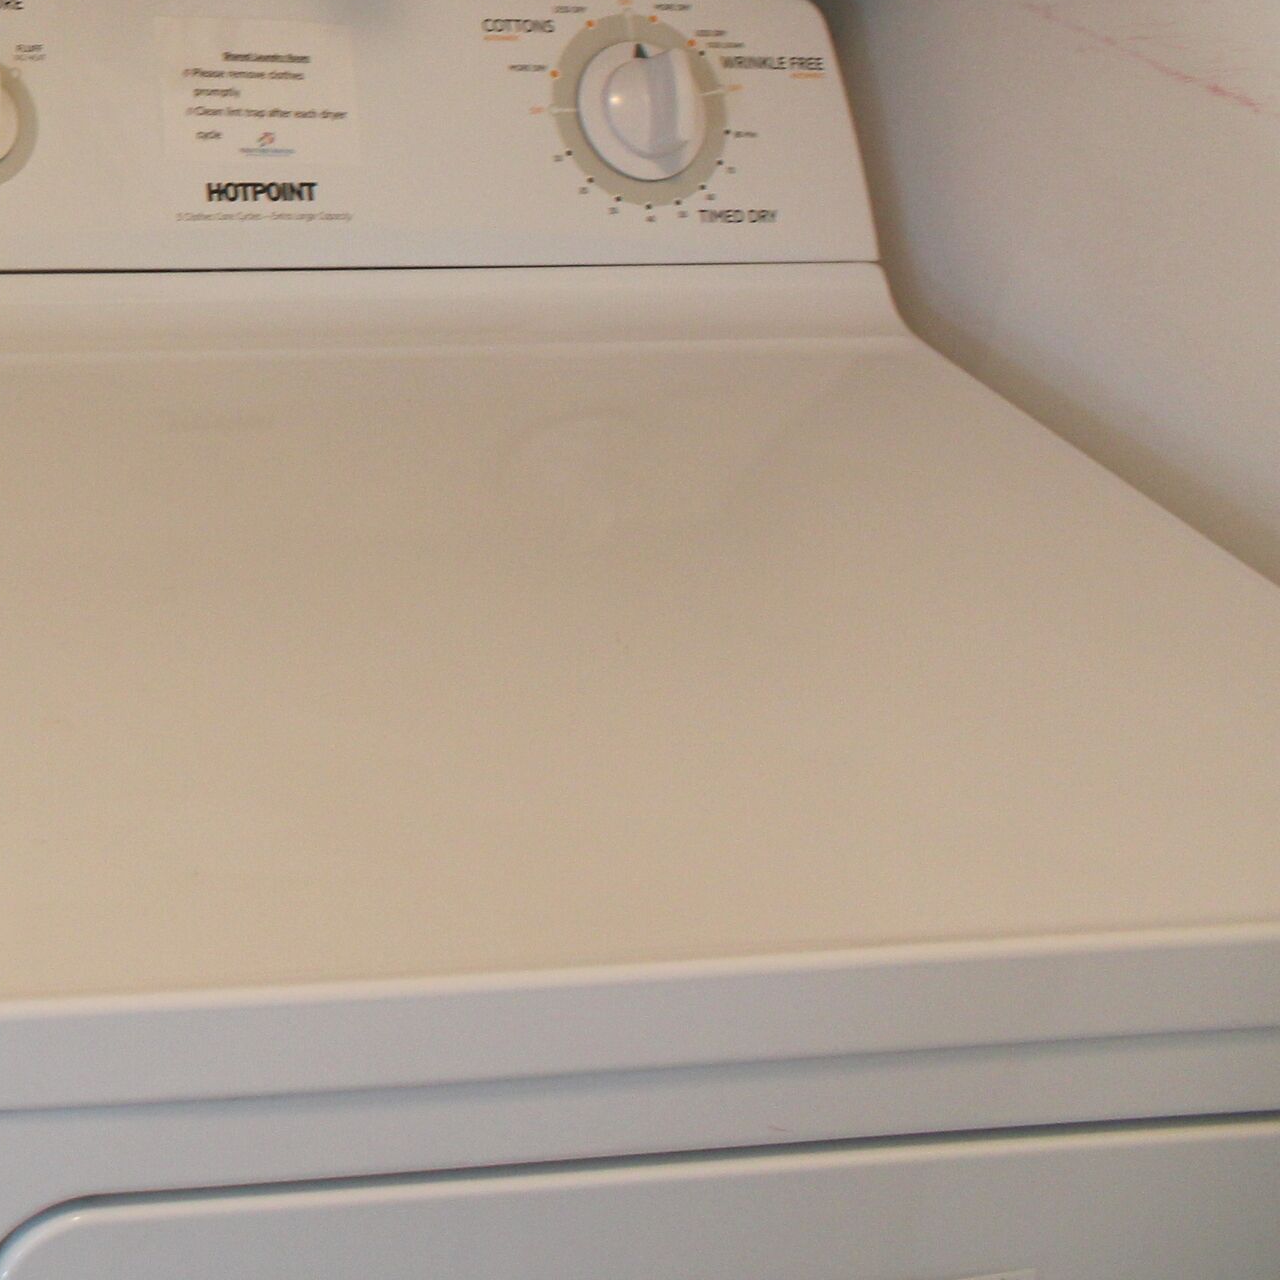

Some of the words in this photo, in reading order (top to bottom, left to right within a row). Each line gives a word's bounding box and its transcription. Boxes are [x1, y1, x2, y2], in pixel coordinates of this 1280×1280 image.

[482, 18, 555, 34] COTTONS
[721, 56, 788, 72] WRINKLE
[790, 57, 825, 72] FREE
[191, 68, 225, 78] Please
[228, 71, 266, 79] remove
[194, 106, 223, 116] Clean
[268, 108, 292, 118] after
[206, 182, 318, 202] HOTPOINT
[697, 209, 746, 223] TIMED
[748, 210, 778, 223] DRY
